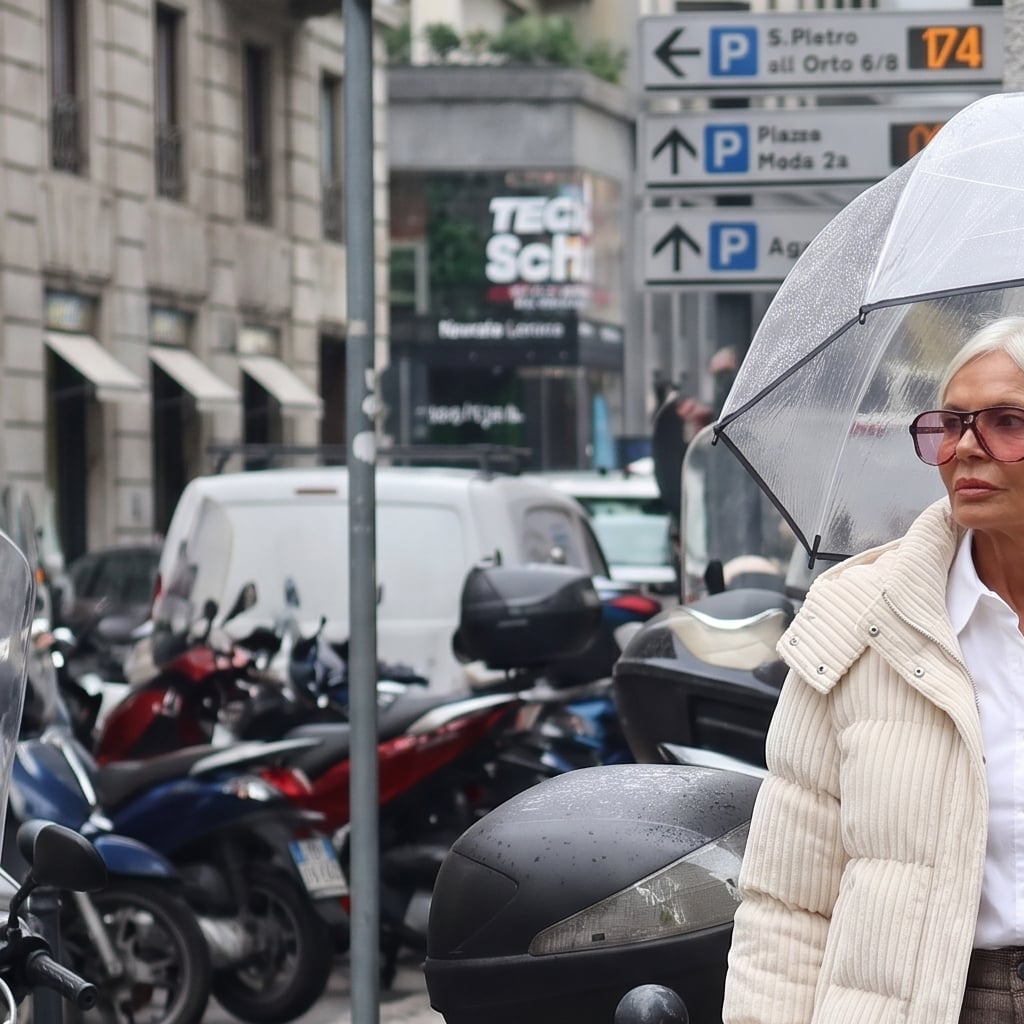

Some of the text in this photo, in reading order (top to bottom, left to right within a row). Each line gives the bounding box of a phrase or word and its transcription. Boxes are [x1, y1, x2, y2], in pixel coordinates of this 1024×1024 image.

[719, 33, 748, 72] P
[802, 54, 854, 73] Orto
[860, 53, 899, 72] 6/8
[922, 26, 983, 70] 174
[713, 131, 742, 168] P
[719, 227, 749, 265] P
